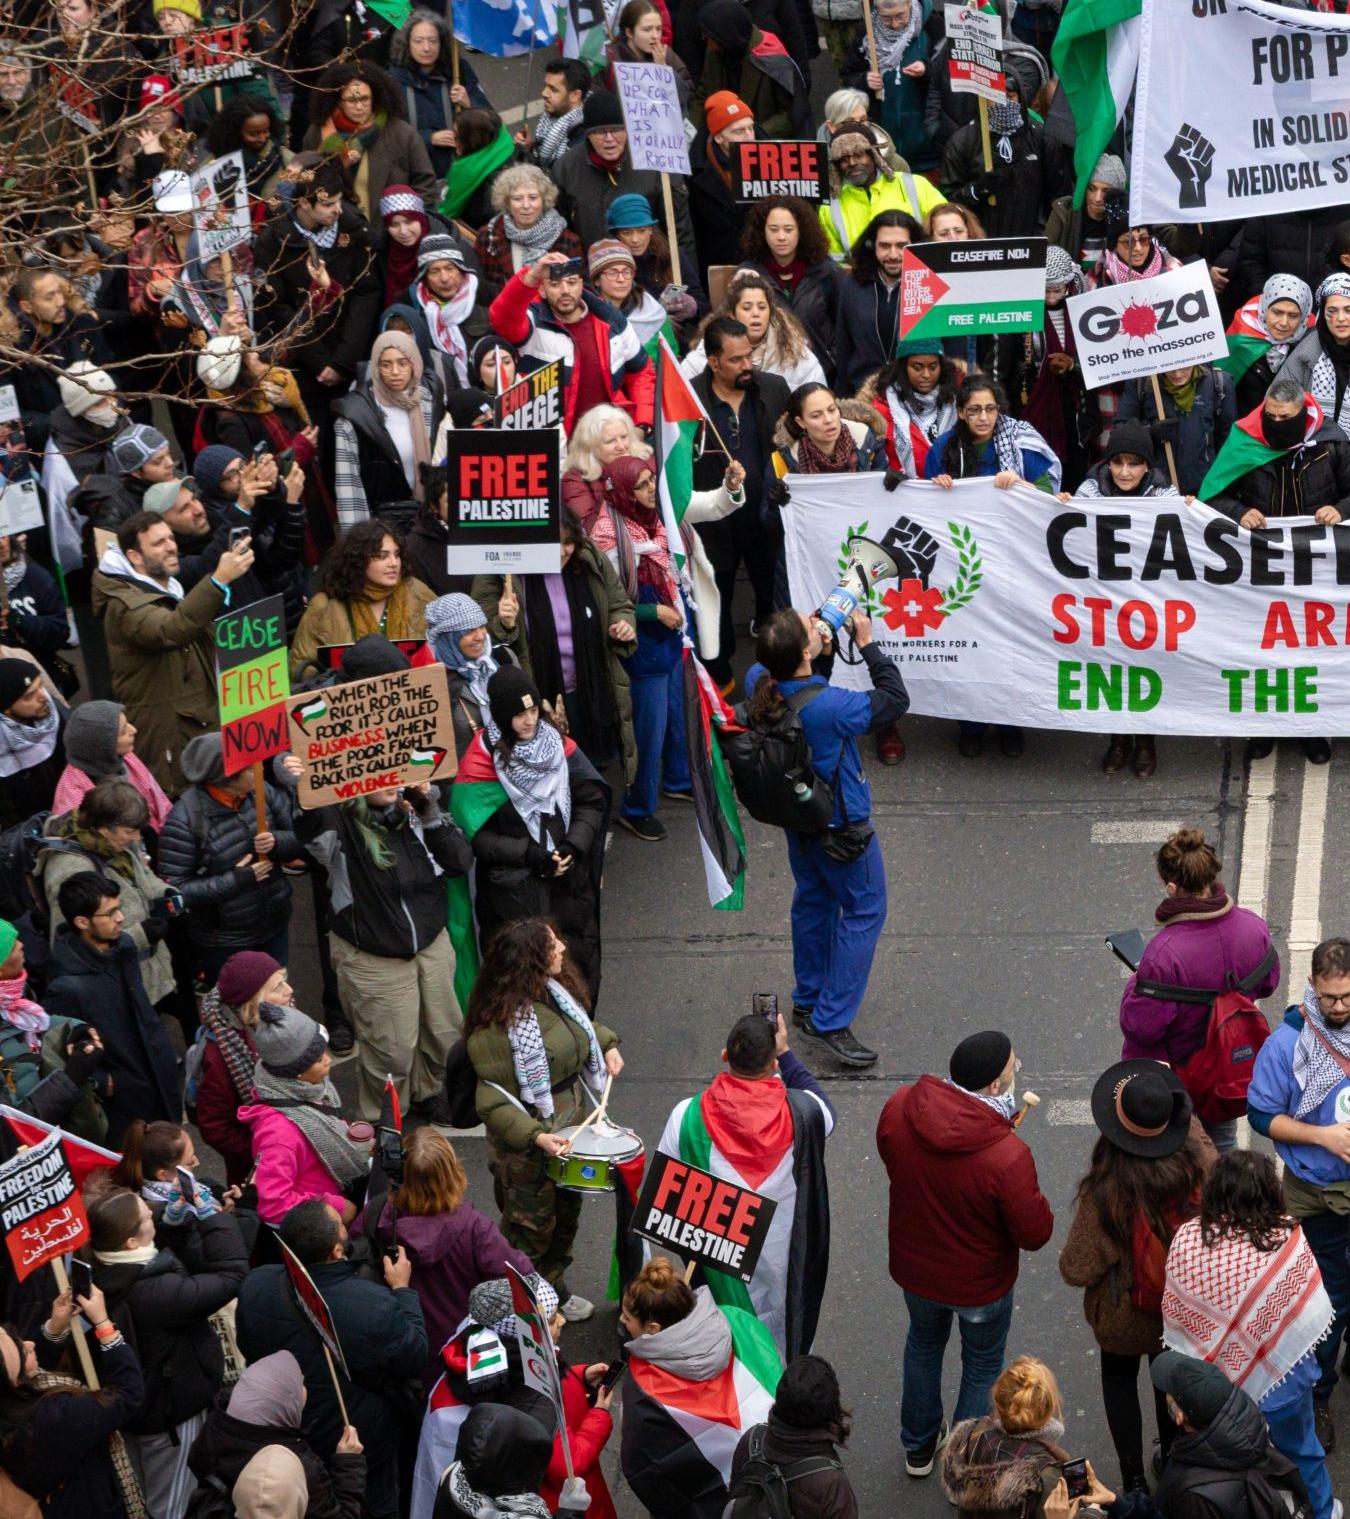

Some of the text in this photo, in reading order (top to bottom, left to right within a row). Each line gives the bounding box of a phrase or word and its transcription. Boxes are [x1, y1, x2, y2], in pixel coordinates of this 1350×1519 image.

[617, 64, 673, 84] STAND
[1252, 32, 1315, 85] FOR
[623, 84, 668, 100] UP FOR
[627, 102, 670, 118] WHAT
[634, 120, 652, 132] IS
[633, 134, 684, 150] MORALLY
[1252, 118, 1276, 149] IN
[645, 150, 685, 170] RIGHT
[740, 143, 819, 180] FREE
[742, 180, 821, 198] PALESTINE
[1227, 161, 1327, 198] MEDICAL
[951, 248, 1030, 263] CEASEFIRE NOW
[904, 268, 930, 282] FROM
[905, 279, 922, 290] THE
[903, 286, 931, 300] RIVER
[905, 294, 934, 307] TO THE
[903, 305, 922, 316] SEA
[948, 311, 1033, 327] FREE PALESTINE
[1087, 329, 1216, 368] Stop the massacre
[500, 362, 560, 419] END THE
[501, 385, 560, 430] SIEGE
[460, 453, 548, 498] FREE
[459, 498, 550, 521] PALESTINE
[485, 551, 500, 562] FOA
[216, 615, 282, 650] CEASE
[1051, 592, 1197, 652] STOP
[902, 640, 968, 648] WORKERS FOR
[908, 653, 959, 663] PALESTINE
[221, 662, 284, 707] FIRE
[381, 674, 411, 692] THE
[1057, 660, 1163, 712] END
[1221, 665, 1319, 713] THE
[329, 684, 434, 722] RICH ROB THE
[225, 712, 290, 758] NOW!
[315, 699, 440, 742] POOR IT'S CALLED
[386, 716, 438, 740] WHEN
[308, 731, 438, 774] THE POOR FIGHT
[310, 751, 411, 790] BACK CALLED
[0, 1147, 65, 1202] FREEDOM
[30, 1183, 43, 1195] for
[1, 1170, 76, 1232] PALESTINE
[652, 1159, 763, 1247] FREE
[20, 1205, 73, 1241] الحرية
[644, 1207, 746, 1269] PALESTINE
[22, 1216, 84, 1266] لفلسطين
